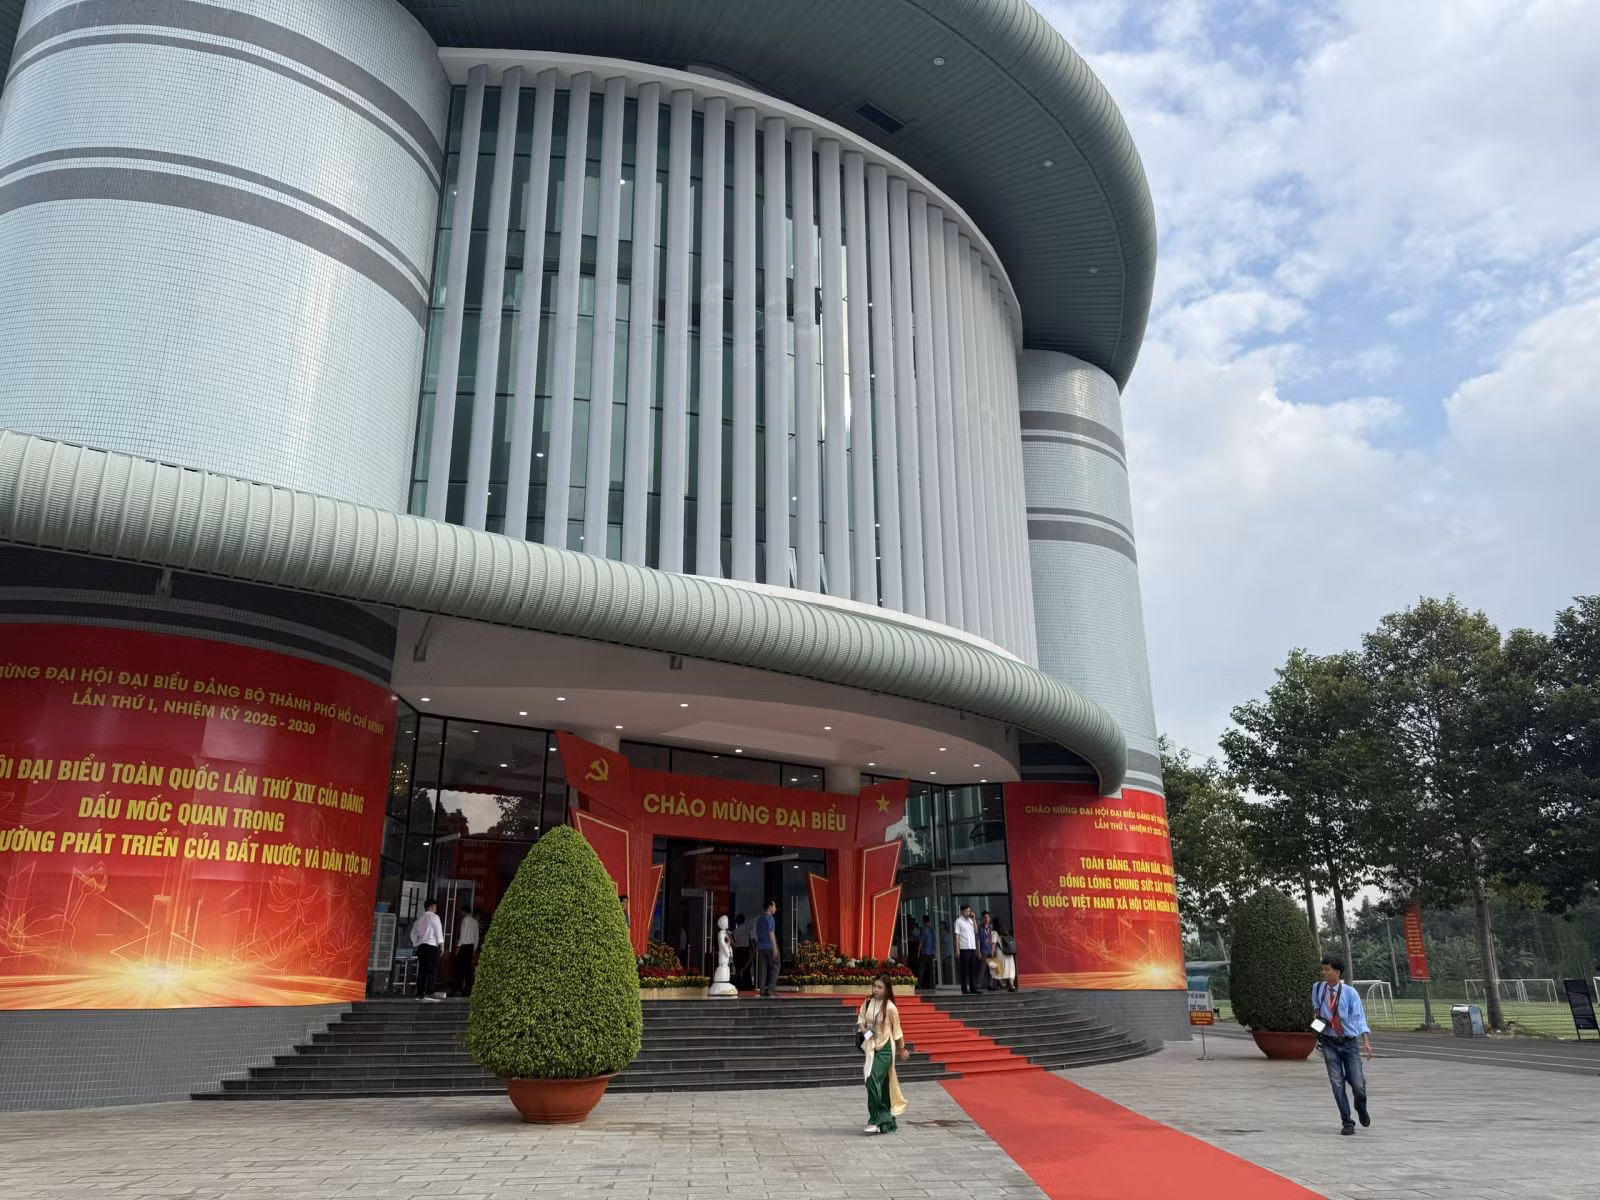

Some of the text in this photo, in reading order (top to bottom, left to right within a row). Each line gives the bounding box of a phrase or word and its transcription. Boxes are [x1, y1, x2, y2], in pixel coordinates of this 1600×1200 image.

[45, 667, 76, 684] ĐẠI
[80, 667, 113, 686] HỘI
[118, 672, 149, 690] ĐẠI
[153, 671, 189, 691] BIỂU
[193, 677, 241, 698] ĐẢNG
[244, 687, 265, 704] BỘ
[269, 692, 312, 712] THÀNH
[353, 714, 368, 729] CHÍ
[368, 719, 385, 735] MINH
[72, 687, 106, 706] LẦN
[111, 694, 146, 710] THỨ
[148, 698, 158, 714] I,
[163, 700, 216, 720] NHIỆM
[220, 705, 240, 721] KỲ
[243, 710, 277, 727] 2025
[287, 718, 316, 735] 2030
[17, 758, 54, 784] ĐẠI
[57, 753, 106, 783] BIỂU
[112, 761, 164, 786] TOÀN
[168, 763, 220, 791] QUỐC
[223, 768, 258, 796] LẦN
[262, 776, 293, 800] THỨ
[292, 781, 317, 804] XIV
[317, 782, 339, 808] CỦA
[340, 787, 365, 814] ĐẢNG
[78, 791, 285, 835] DẤU MỐC QUAN TRỌNG
[643, 791, 846, 833] CHÀO MỪNG ĐẠI BIỂU
[1079, 807, 1093, 817] ĐẠI
[1094, 806, 1109, 818] HỘI
[1110, 809, 1122, 819] ĐẠI
[60, 828, 116, 855] PHÁT
[121, 828, 179, 857] TRIỂN
[183, 832, 220, 860] CỦA
[225, 835, 259, 864] ĐẤT
[261, 842, 302, 867] NƯỚC
[304, 845, 319, 869] VÀ
[321, 848, 344, 872] DÂN
[344, 851, 359, 877] TỘC
[360, 855, 372, 876] TA!
[1080, 855, 1104, 870] TOÀN
[1106, 855, 1131, 873] ĐẢNG,
[1041, 891, 1070, 909] QUỐC
[1071, 894, 1091, 911] VIỆT
[1093, 897, 1115, 909] NAM
[1116, 896, 1128, 910] XÃ
[1129, 896, 1142, 912] HỘI
[1087, 874, 1112, 890] LÒNG
[1114, 877, 1140, 891] CHUNG
